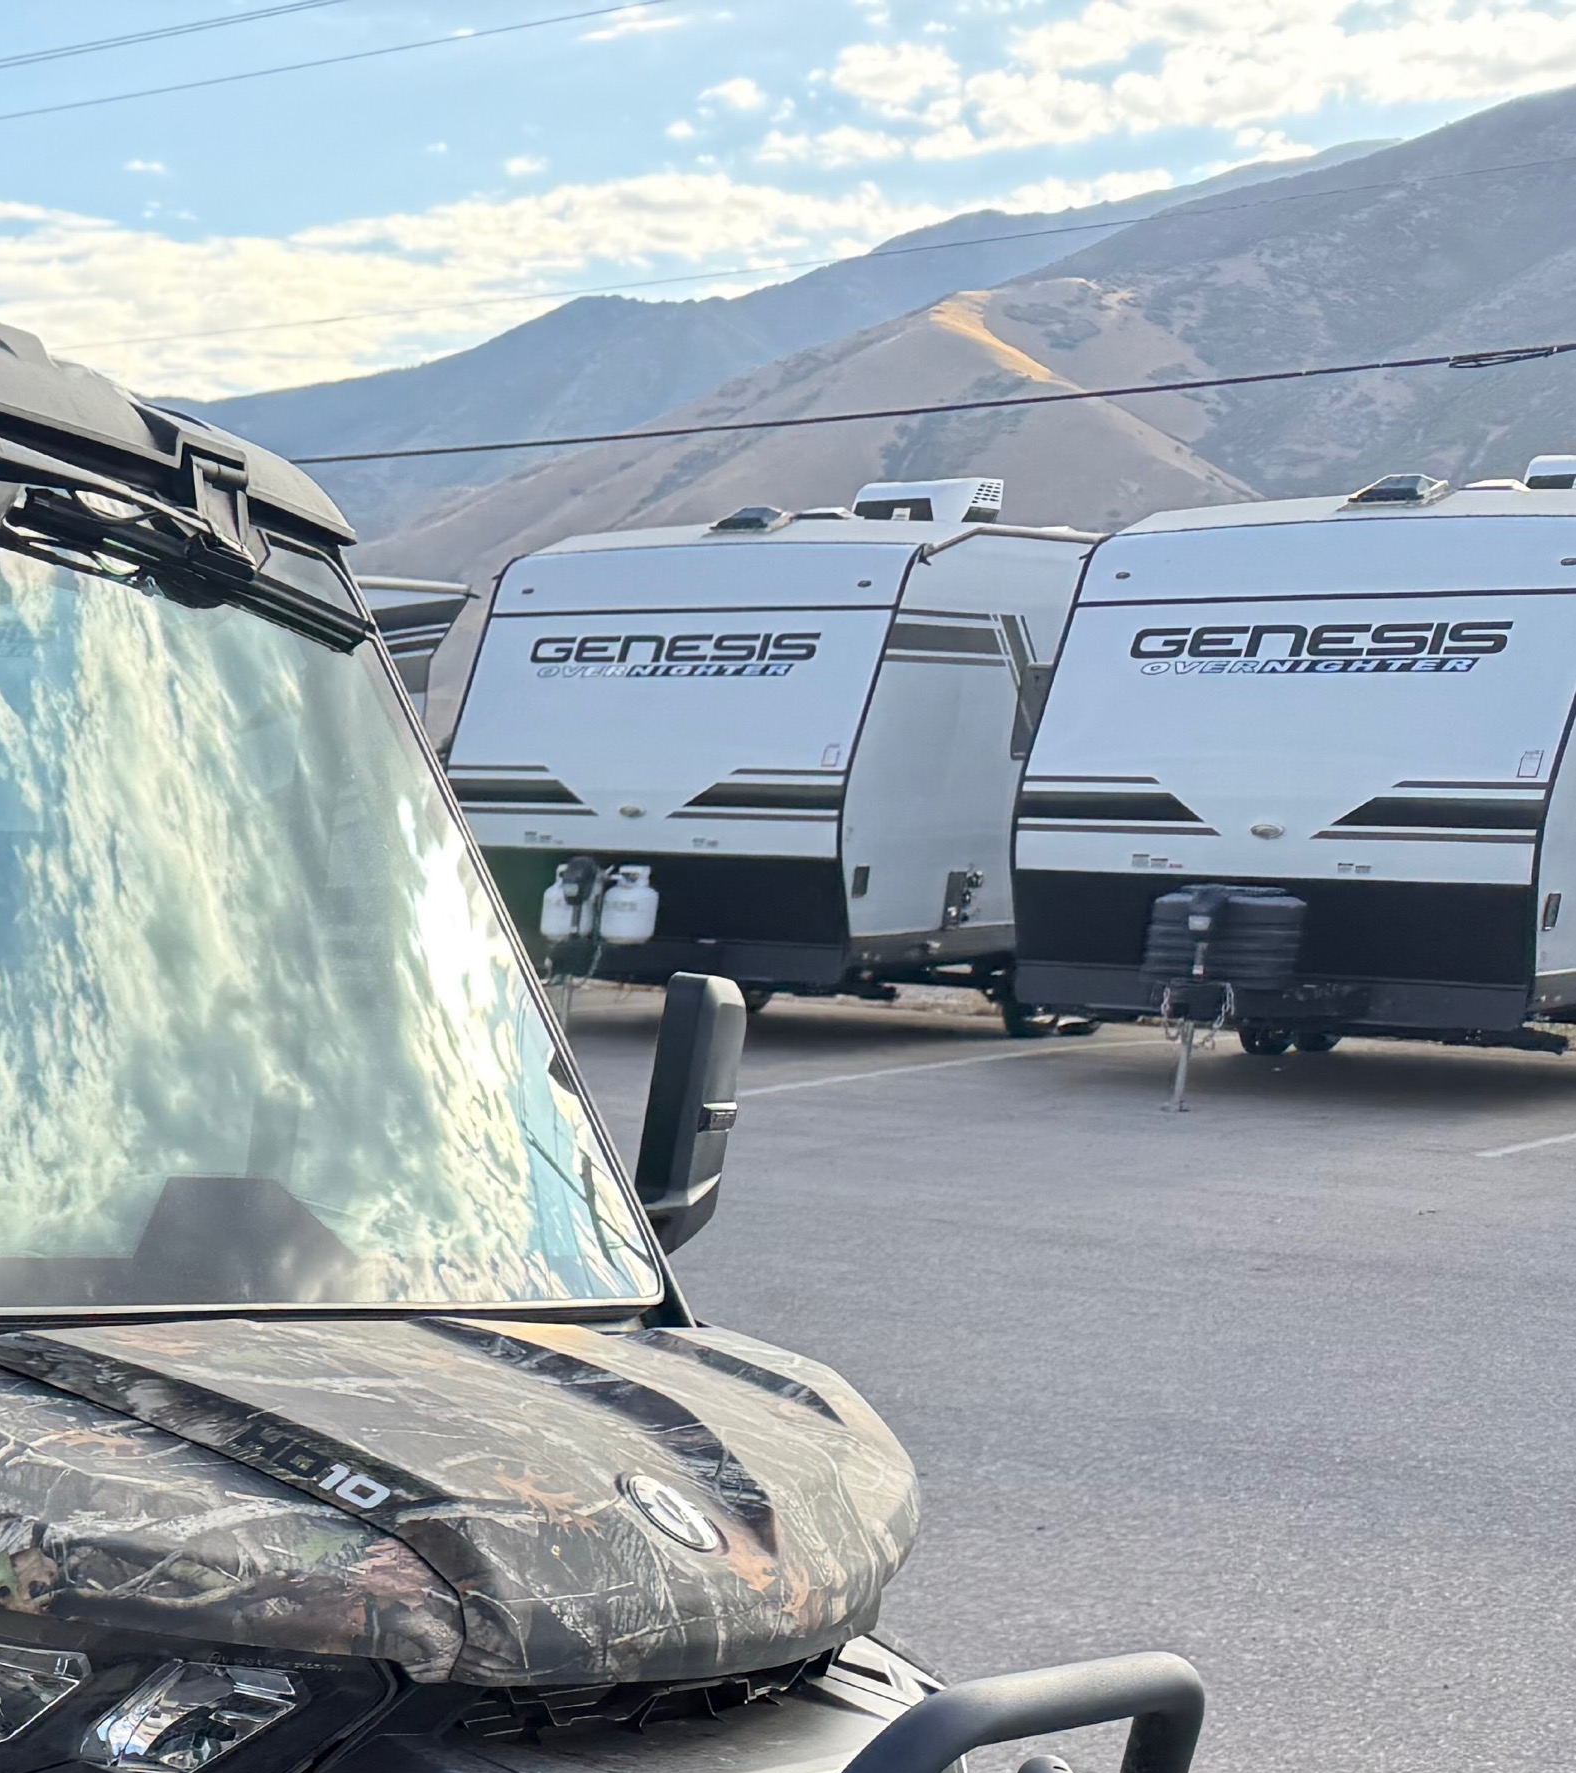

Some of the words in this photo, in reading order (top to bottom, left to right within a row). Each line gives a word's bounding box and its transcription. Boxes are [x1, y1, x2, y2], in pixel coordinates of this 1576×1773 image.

[529, 632, 822, 664] GENESIS
[1129, 620, 1514, 658] GENESIS
[536, 662, 795, 678] OVERNIGHTER
[1139, 657, 1481, 675] OVERNIGHTER
[235, 1423, 391, 1509] HD10
